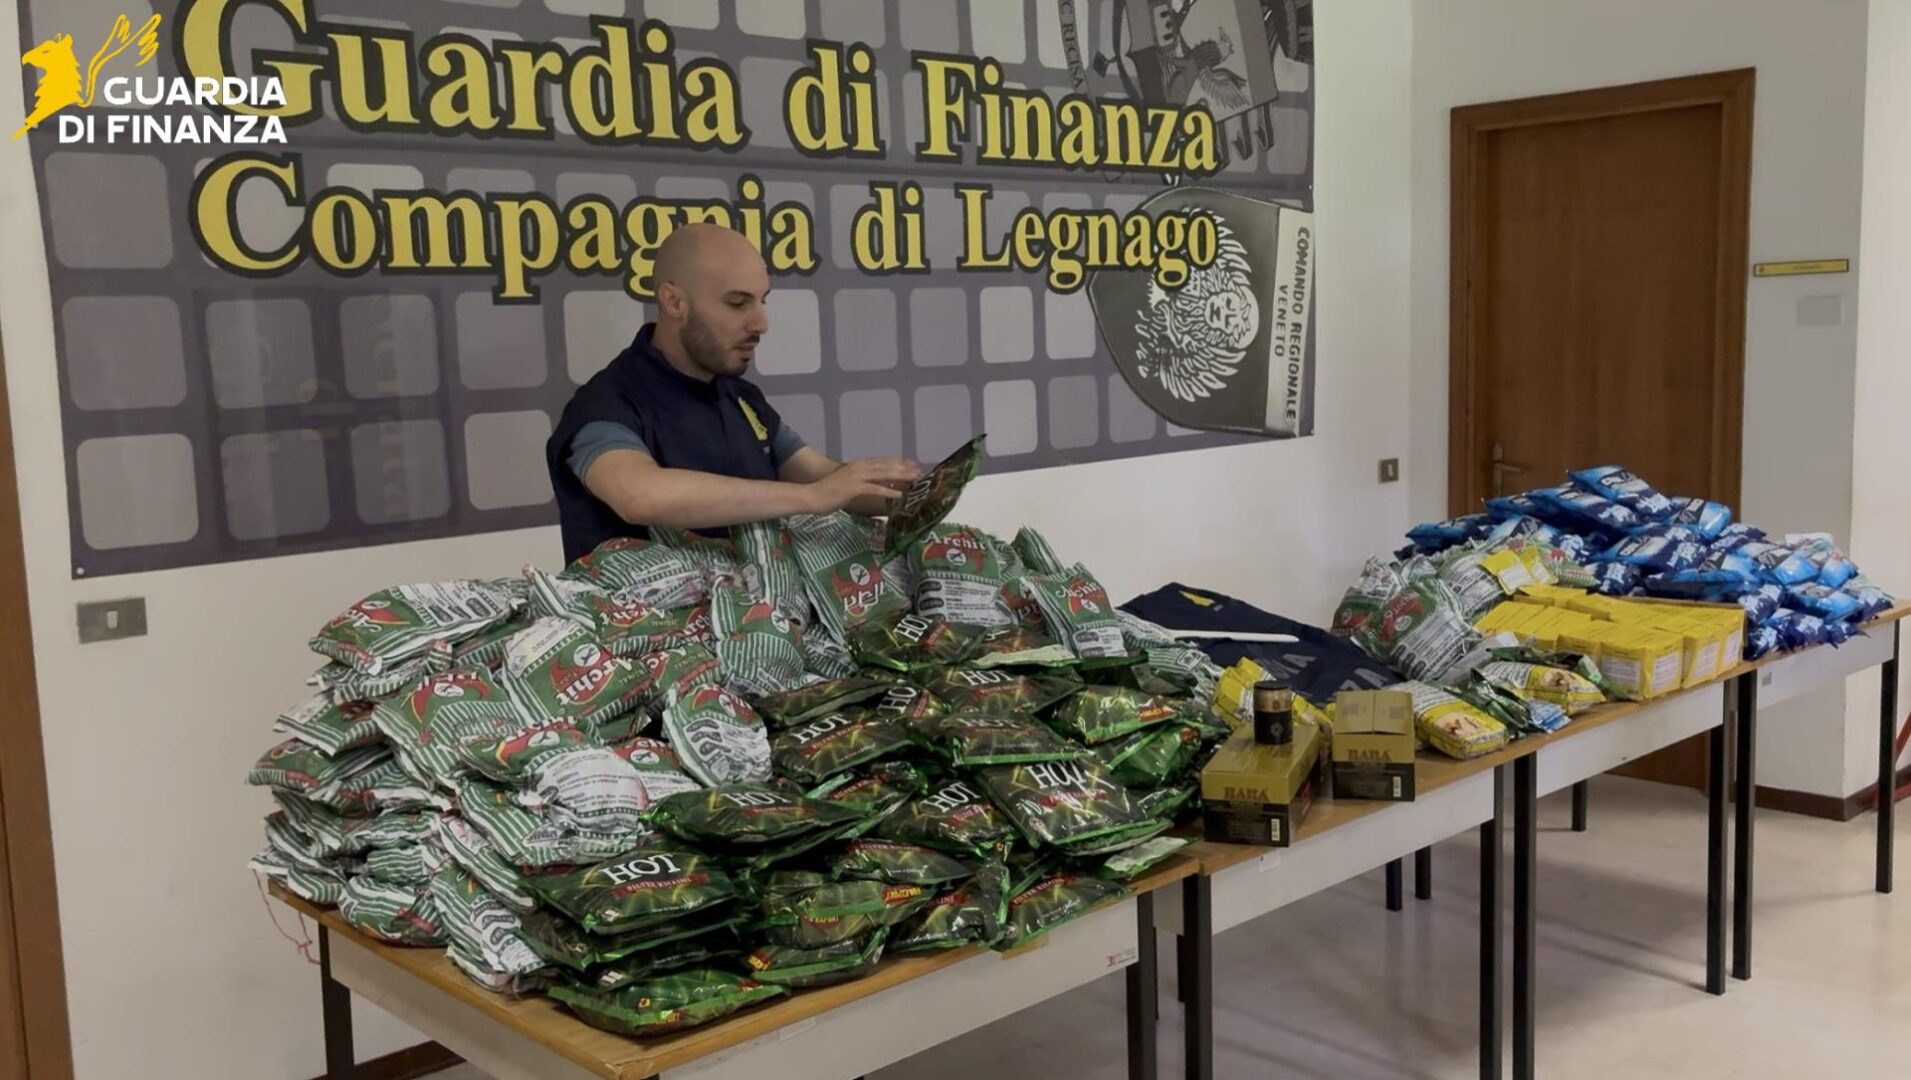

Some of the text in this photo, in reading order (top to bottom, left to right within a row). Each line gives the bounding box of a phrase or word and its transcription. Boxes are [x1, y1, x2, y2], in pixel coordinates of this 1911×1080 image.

[182, 0, 1218, 173] Guardia di Finanza
[854, 181, 927, 270] di
[957, 187, 1218, 289] Legnago
[1274, 284, 1289, 357] VENETO
[1286, 227, 1310, 420] COMANDO REGIONALE
[555, 656, 633, 706] Archit
[877, 686, 918, 714] HO
[791, 712, 852, 744] HOT
[920, 781, 982, 813] HOT
[599, 853, 681, 886] HOT
